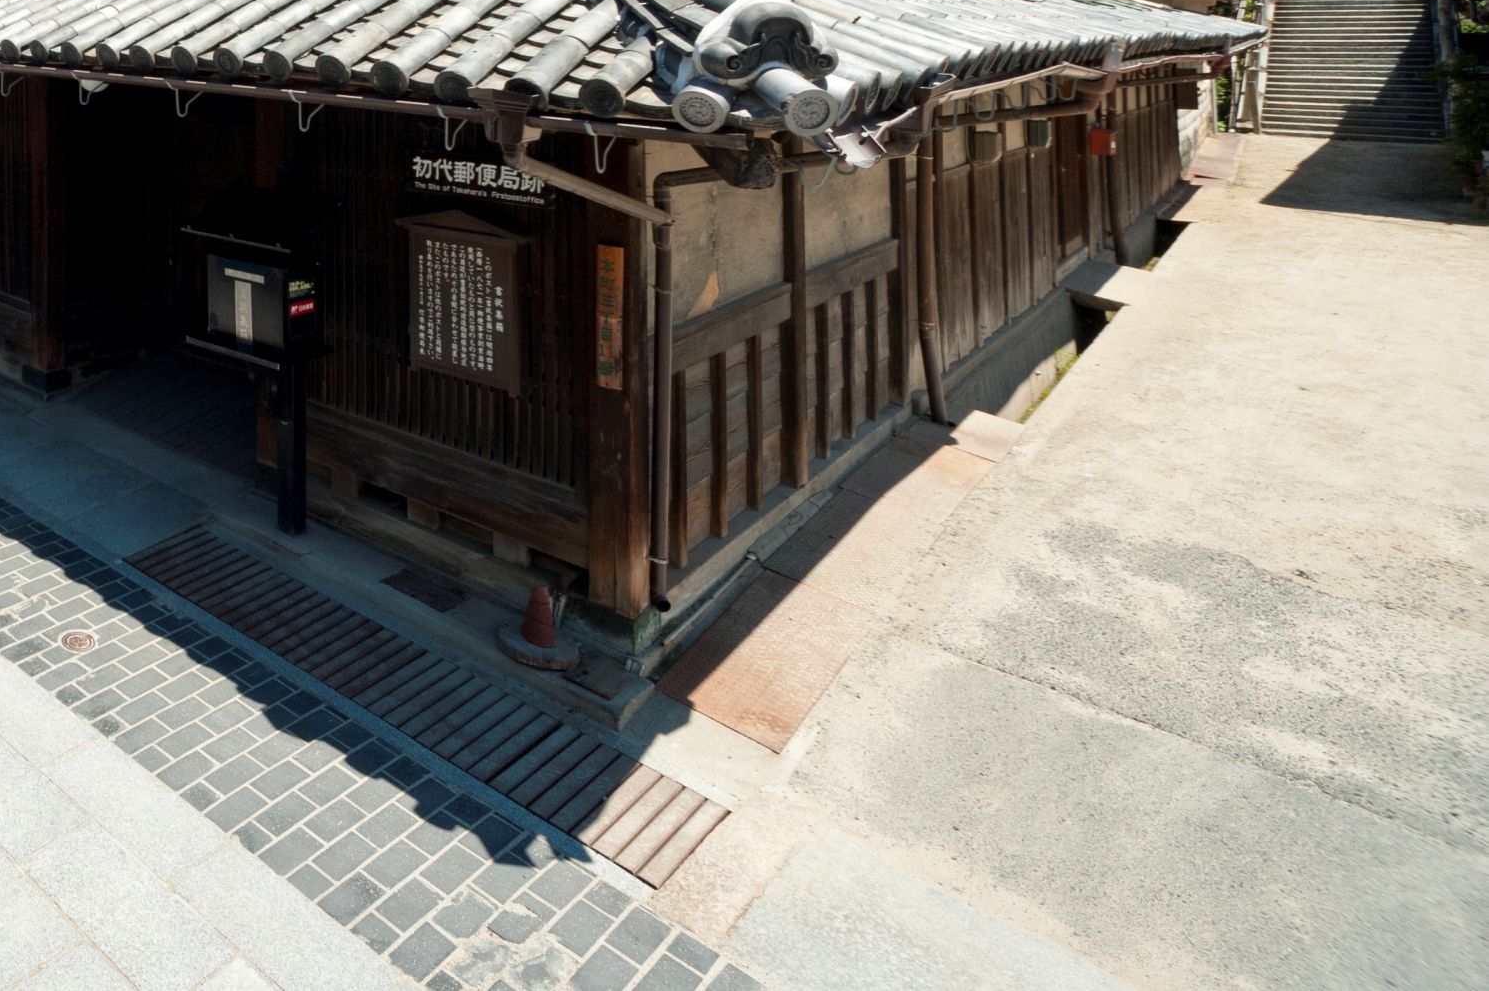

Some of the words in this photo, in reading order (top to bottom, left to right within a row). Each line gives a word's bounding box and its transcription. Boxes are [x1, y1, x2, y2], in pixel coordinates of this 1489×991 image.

[412, 156, 545, 194] 初代郵便局跡
[414, 181, 426, 190] The
[427, 182, 441, 191] Site
[442, 185, 451, 193] of
[494, 286, 504, 333] 書状集箱
